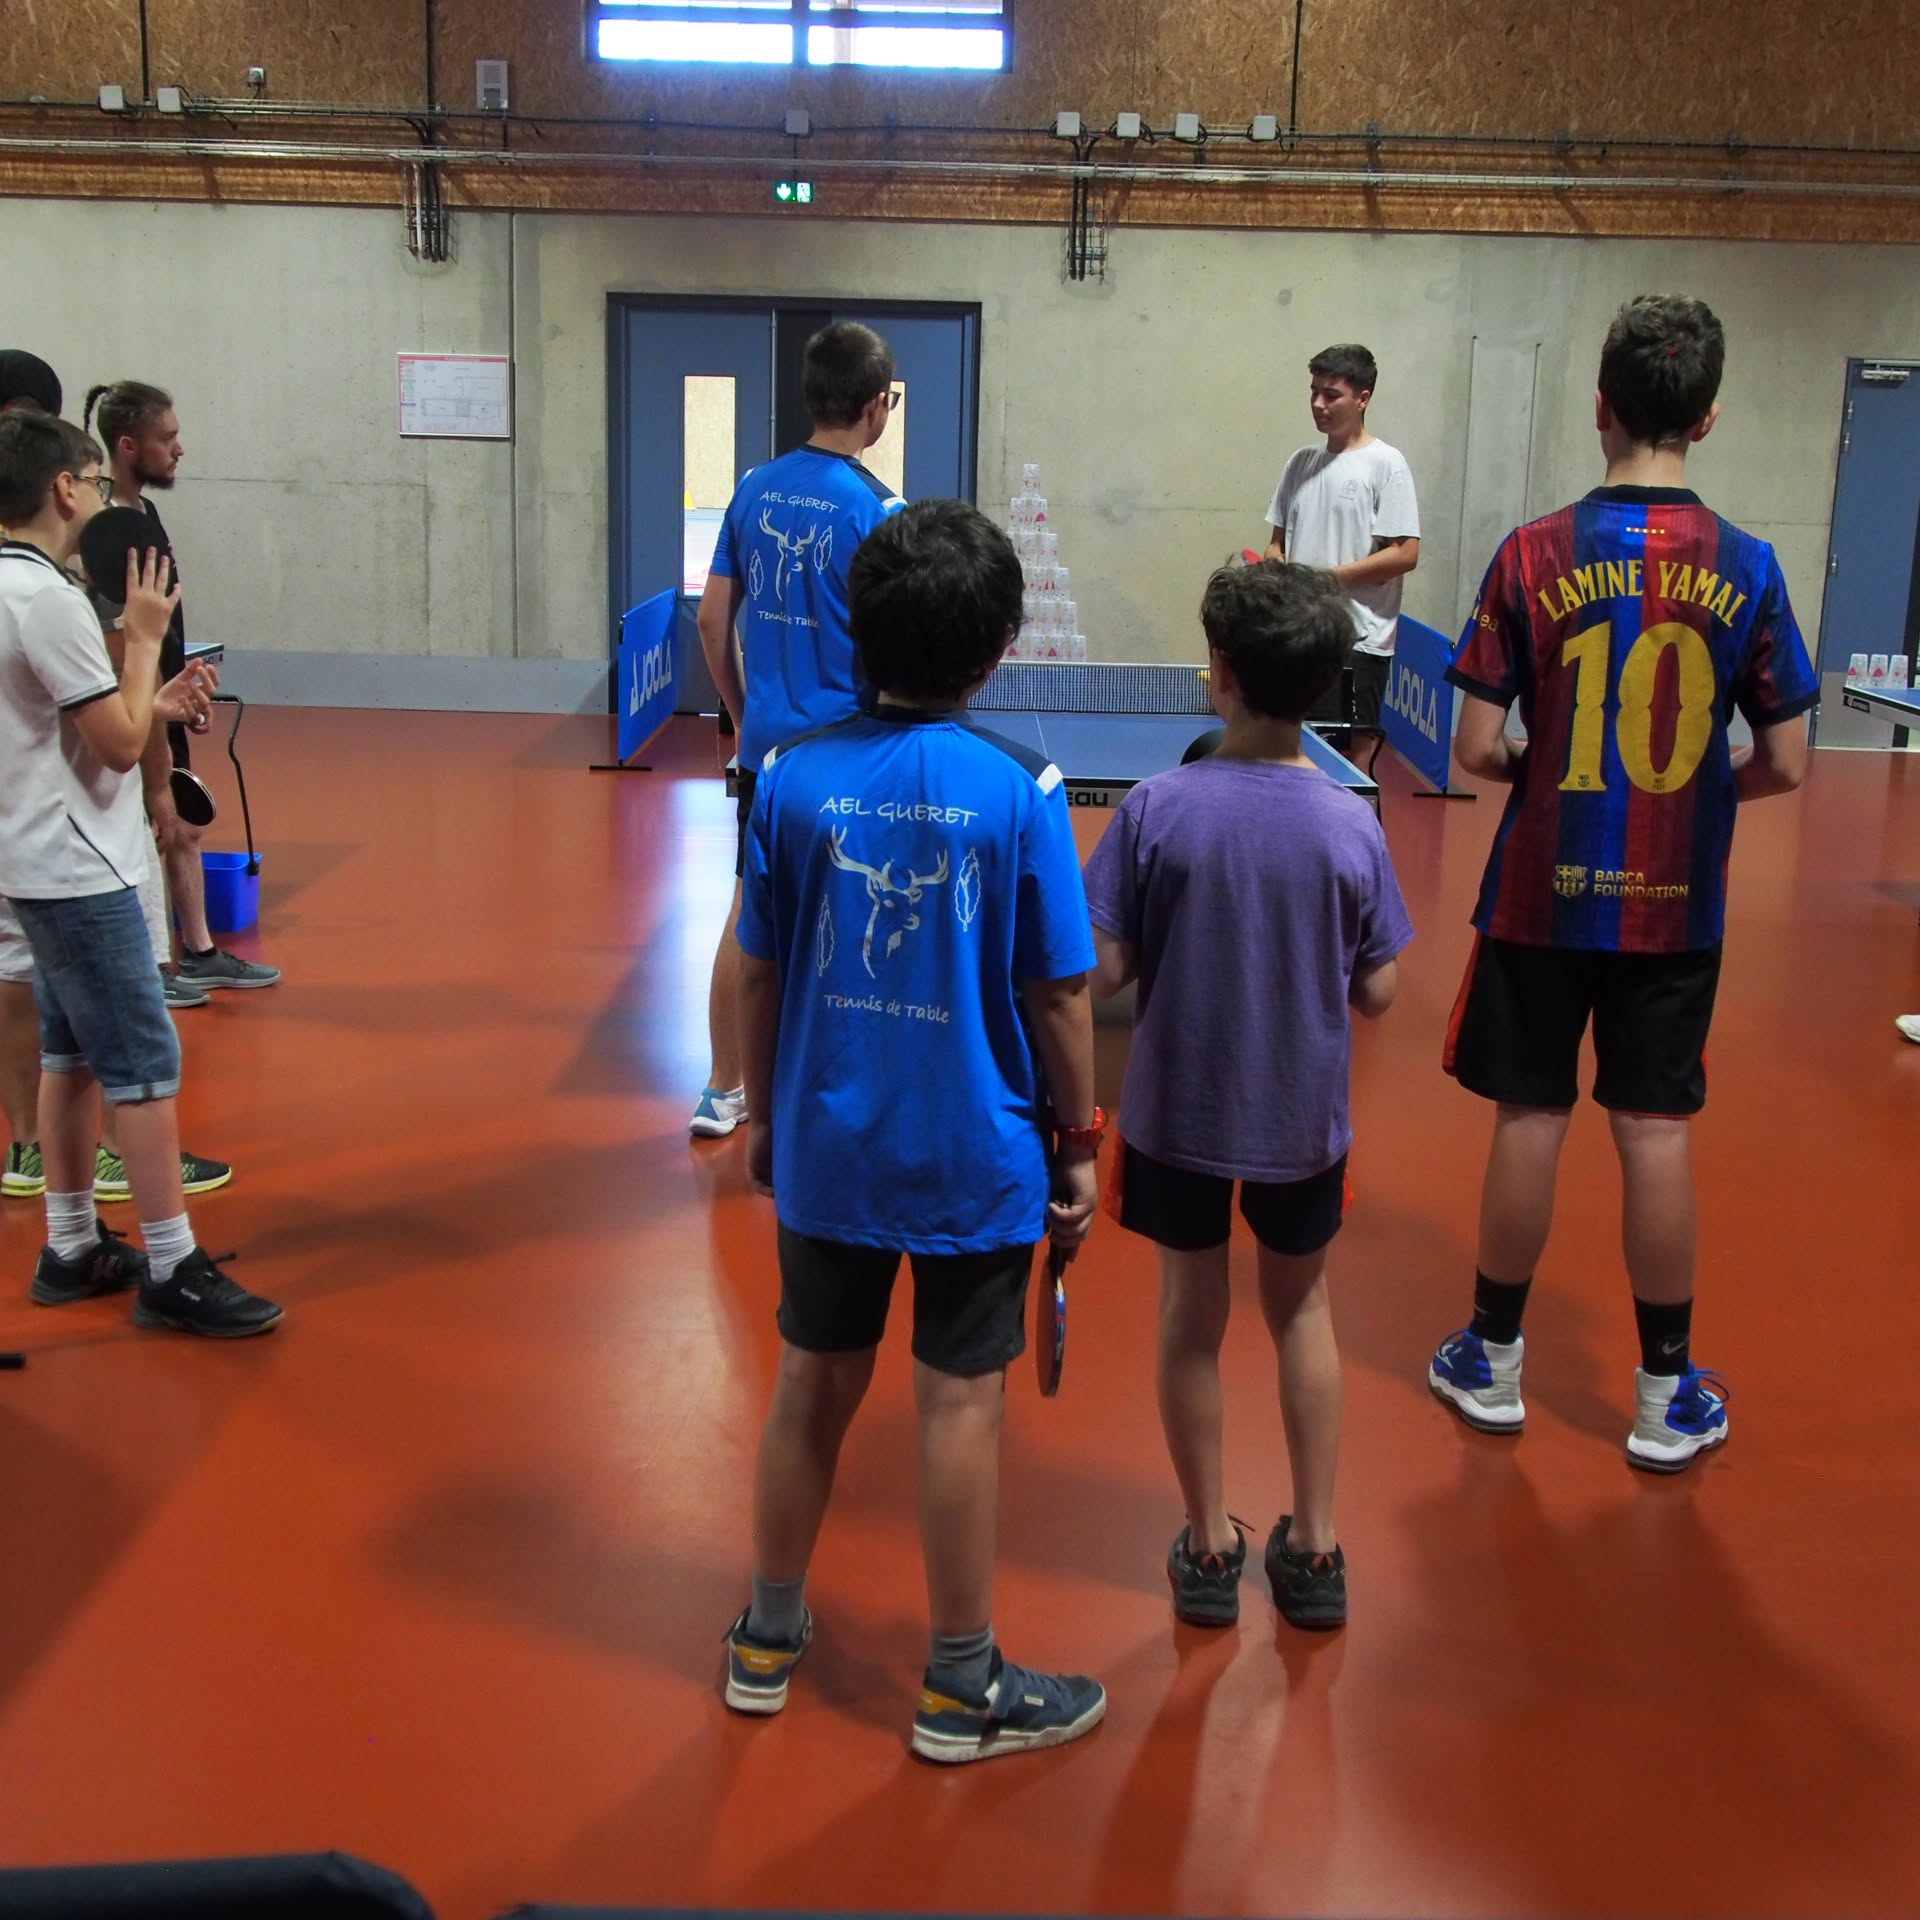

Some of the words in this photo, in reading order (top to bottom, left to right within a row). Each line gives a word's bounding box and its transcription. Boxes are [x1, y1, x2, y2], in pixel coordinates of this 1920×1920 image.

[760, 491, 785, 503] AEL
[788, 495, 839, 513] GUERET
[1538, 560, 1643, 622] LAMINE
[1659, 560, 1748, 628] YAMAL
[639, 638, 673, 709] JOOLA
[1394, 664, 1438, 744] JOOLA
[1558, 621, 1715, 793] 10
[819, 796, 871, 814] AEL
[877, 802, 979, 827] GUERET
[1593, 884, 1690, 898] FOUNDATION
[824, 994, 882, 1012] Tennis
[886, 1000, 901, 1017] de
[904, 1004, 950, 1024] Table
